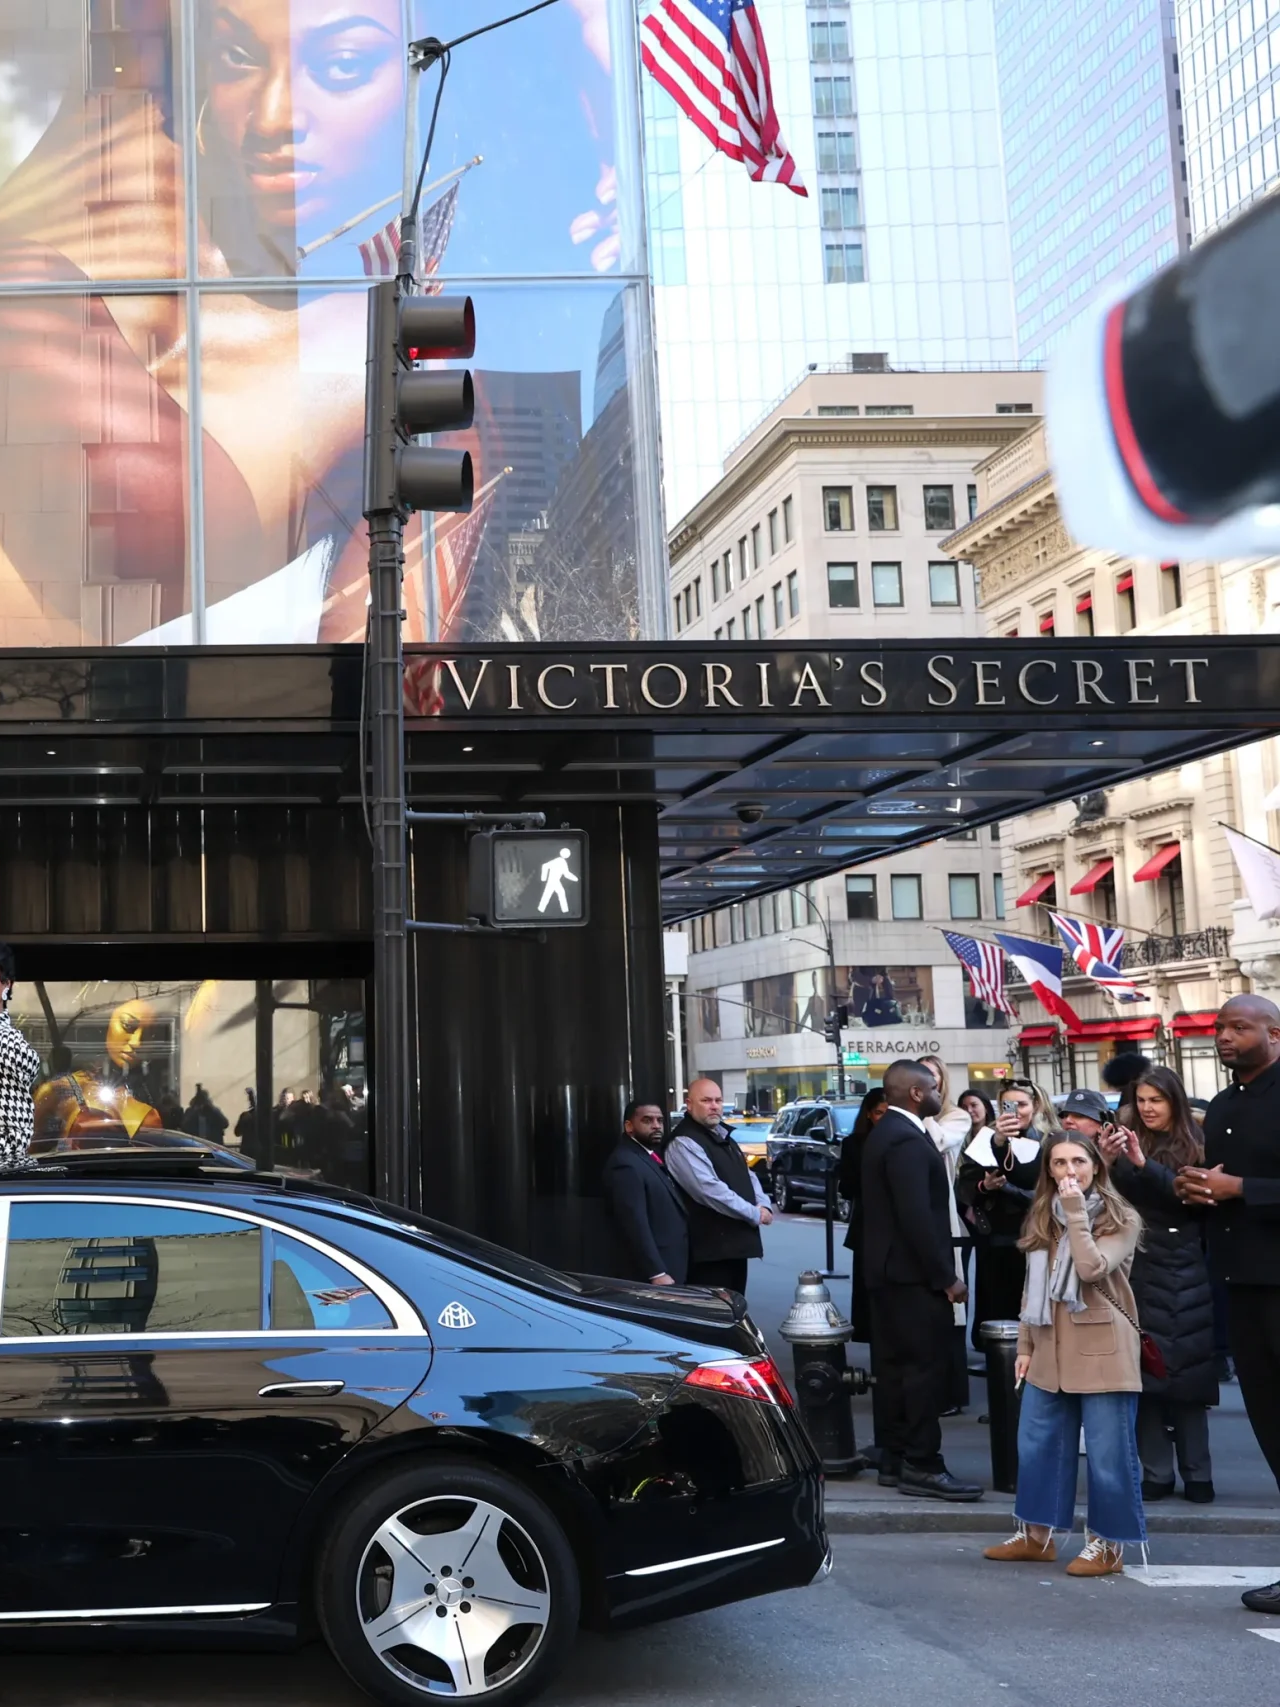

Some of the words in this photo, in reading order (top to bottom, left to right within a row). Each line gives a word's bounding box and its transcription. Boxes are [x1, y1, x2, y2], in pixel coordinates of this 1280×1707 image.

[440, 656, 889, 711] VICTORIA'S
[926, 655, 1209, 706] SECRET
[847, 1041, 940, 1053] FERRAGAMO
